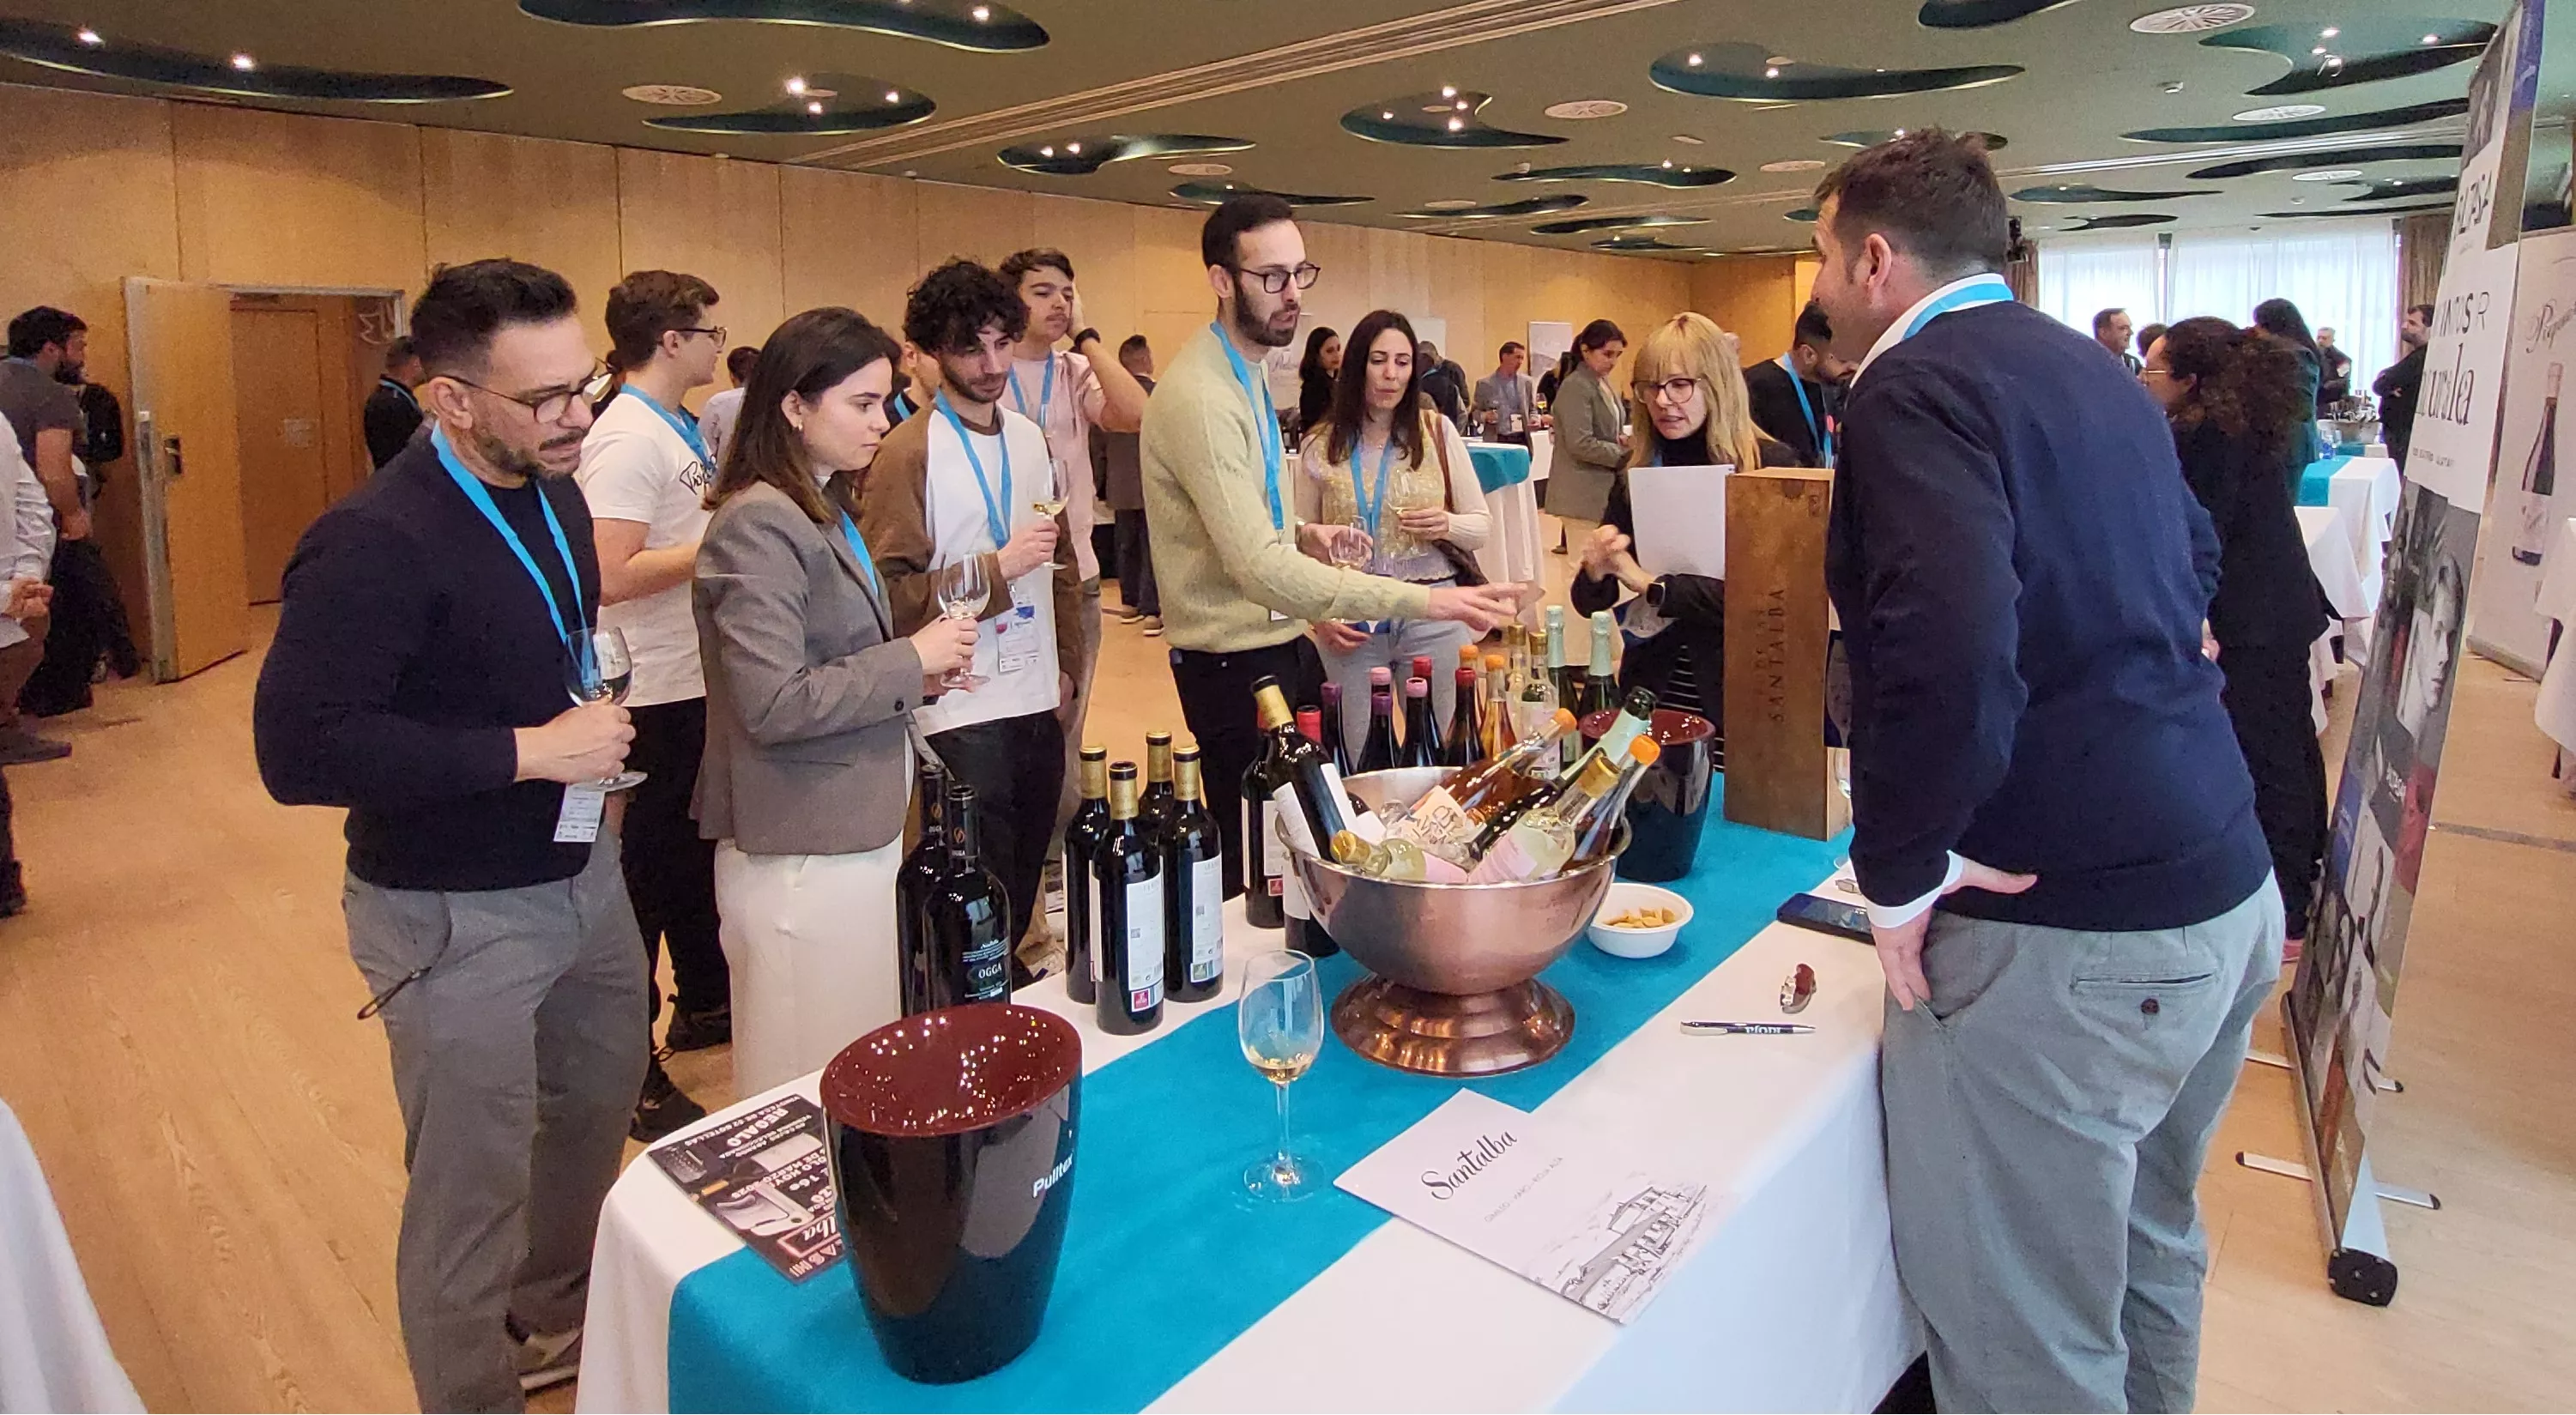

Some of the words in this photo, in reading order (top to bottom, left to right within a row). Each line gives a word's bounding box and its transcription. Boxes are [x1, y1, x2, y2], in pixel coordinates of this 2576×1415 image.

[978, 962, 1002, 978] OGGA
[684, 1120, 732, 1146] BOTELLAS
[726, 1108, 789, 1146] REGALO
[1421, 1131, 1517, 1200] Santalba
